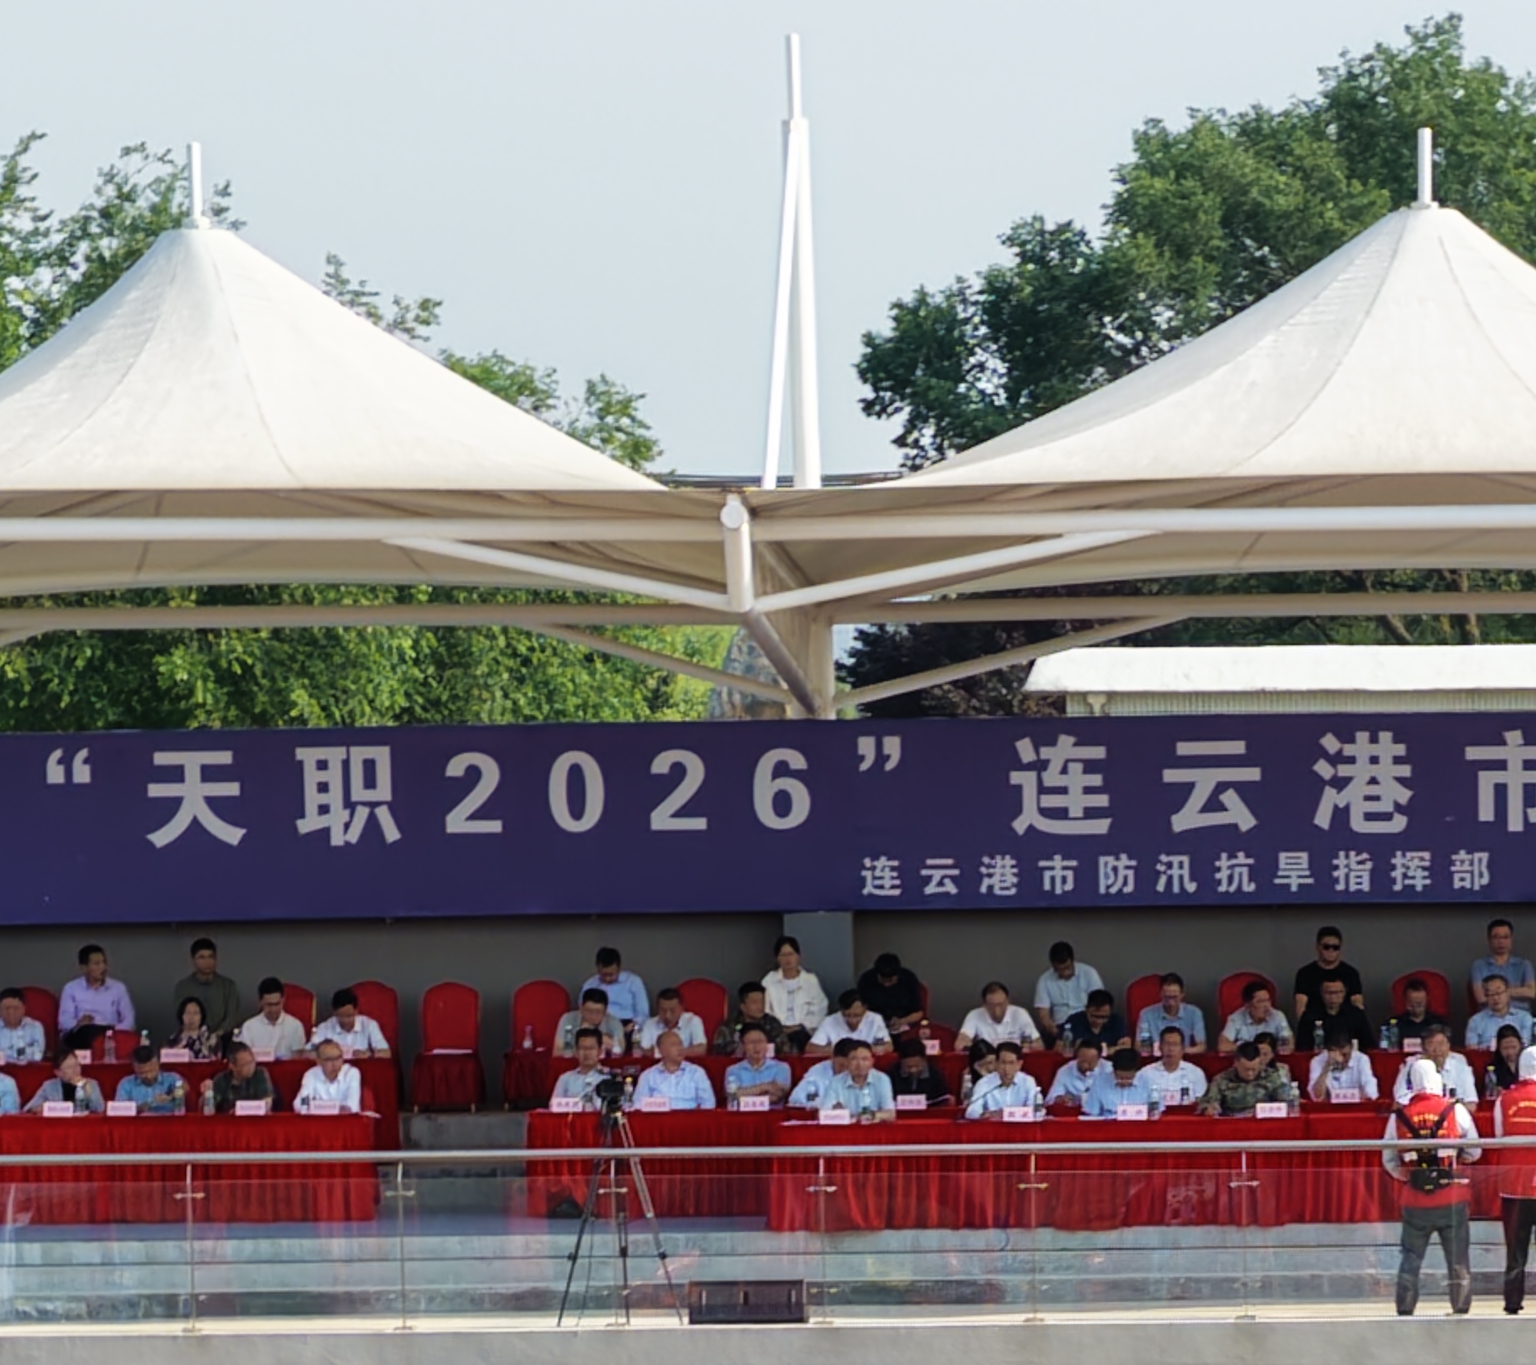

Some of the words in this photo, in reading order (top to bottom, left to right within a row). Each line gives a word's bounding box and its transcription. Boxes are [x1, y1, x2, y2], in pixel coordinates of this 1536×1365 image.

[861, 850, 1492, 897] 连云港市防汛抗旱指挥部
